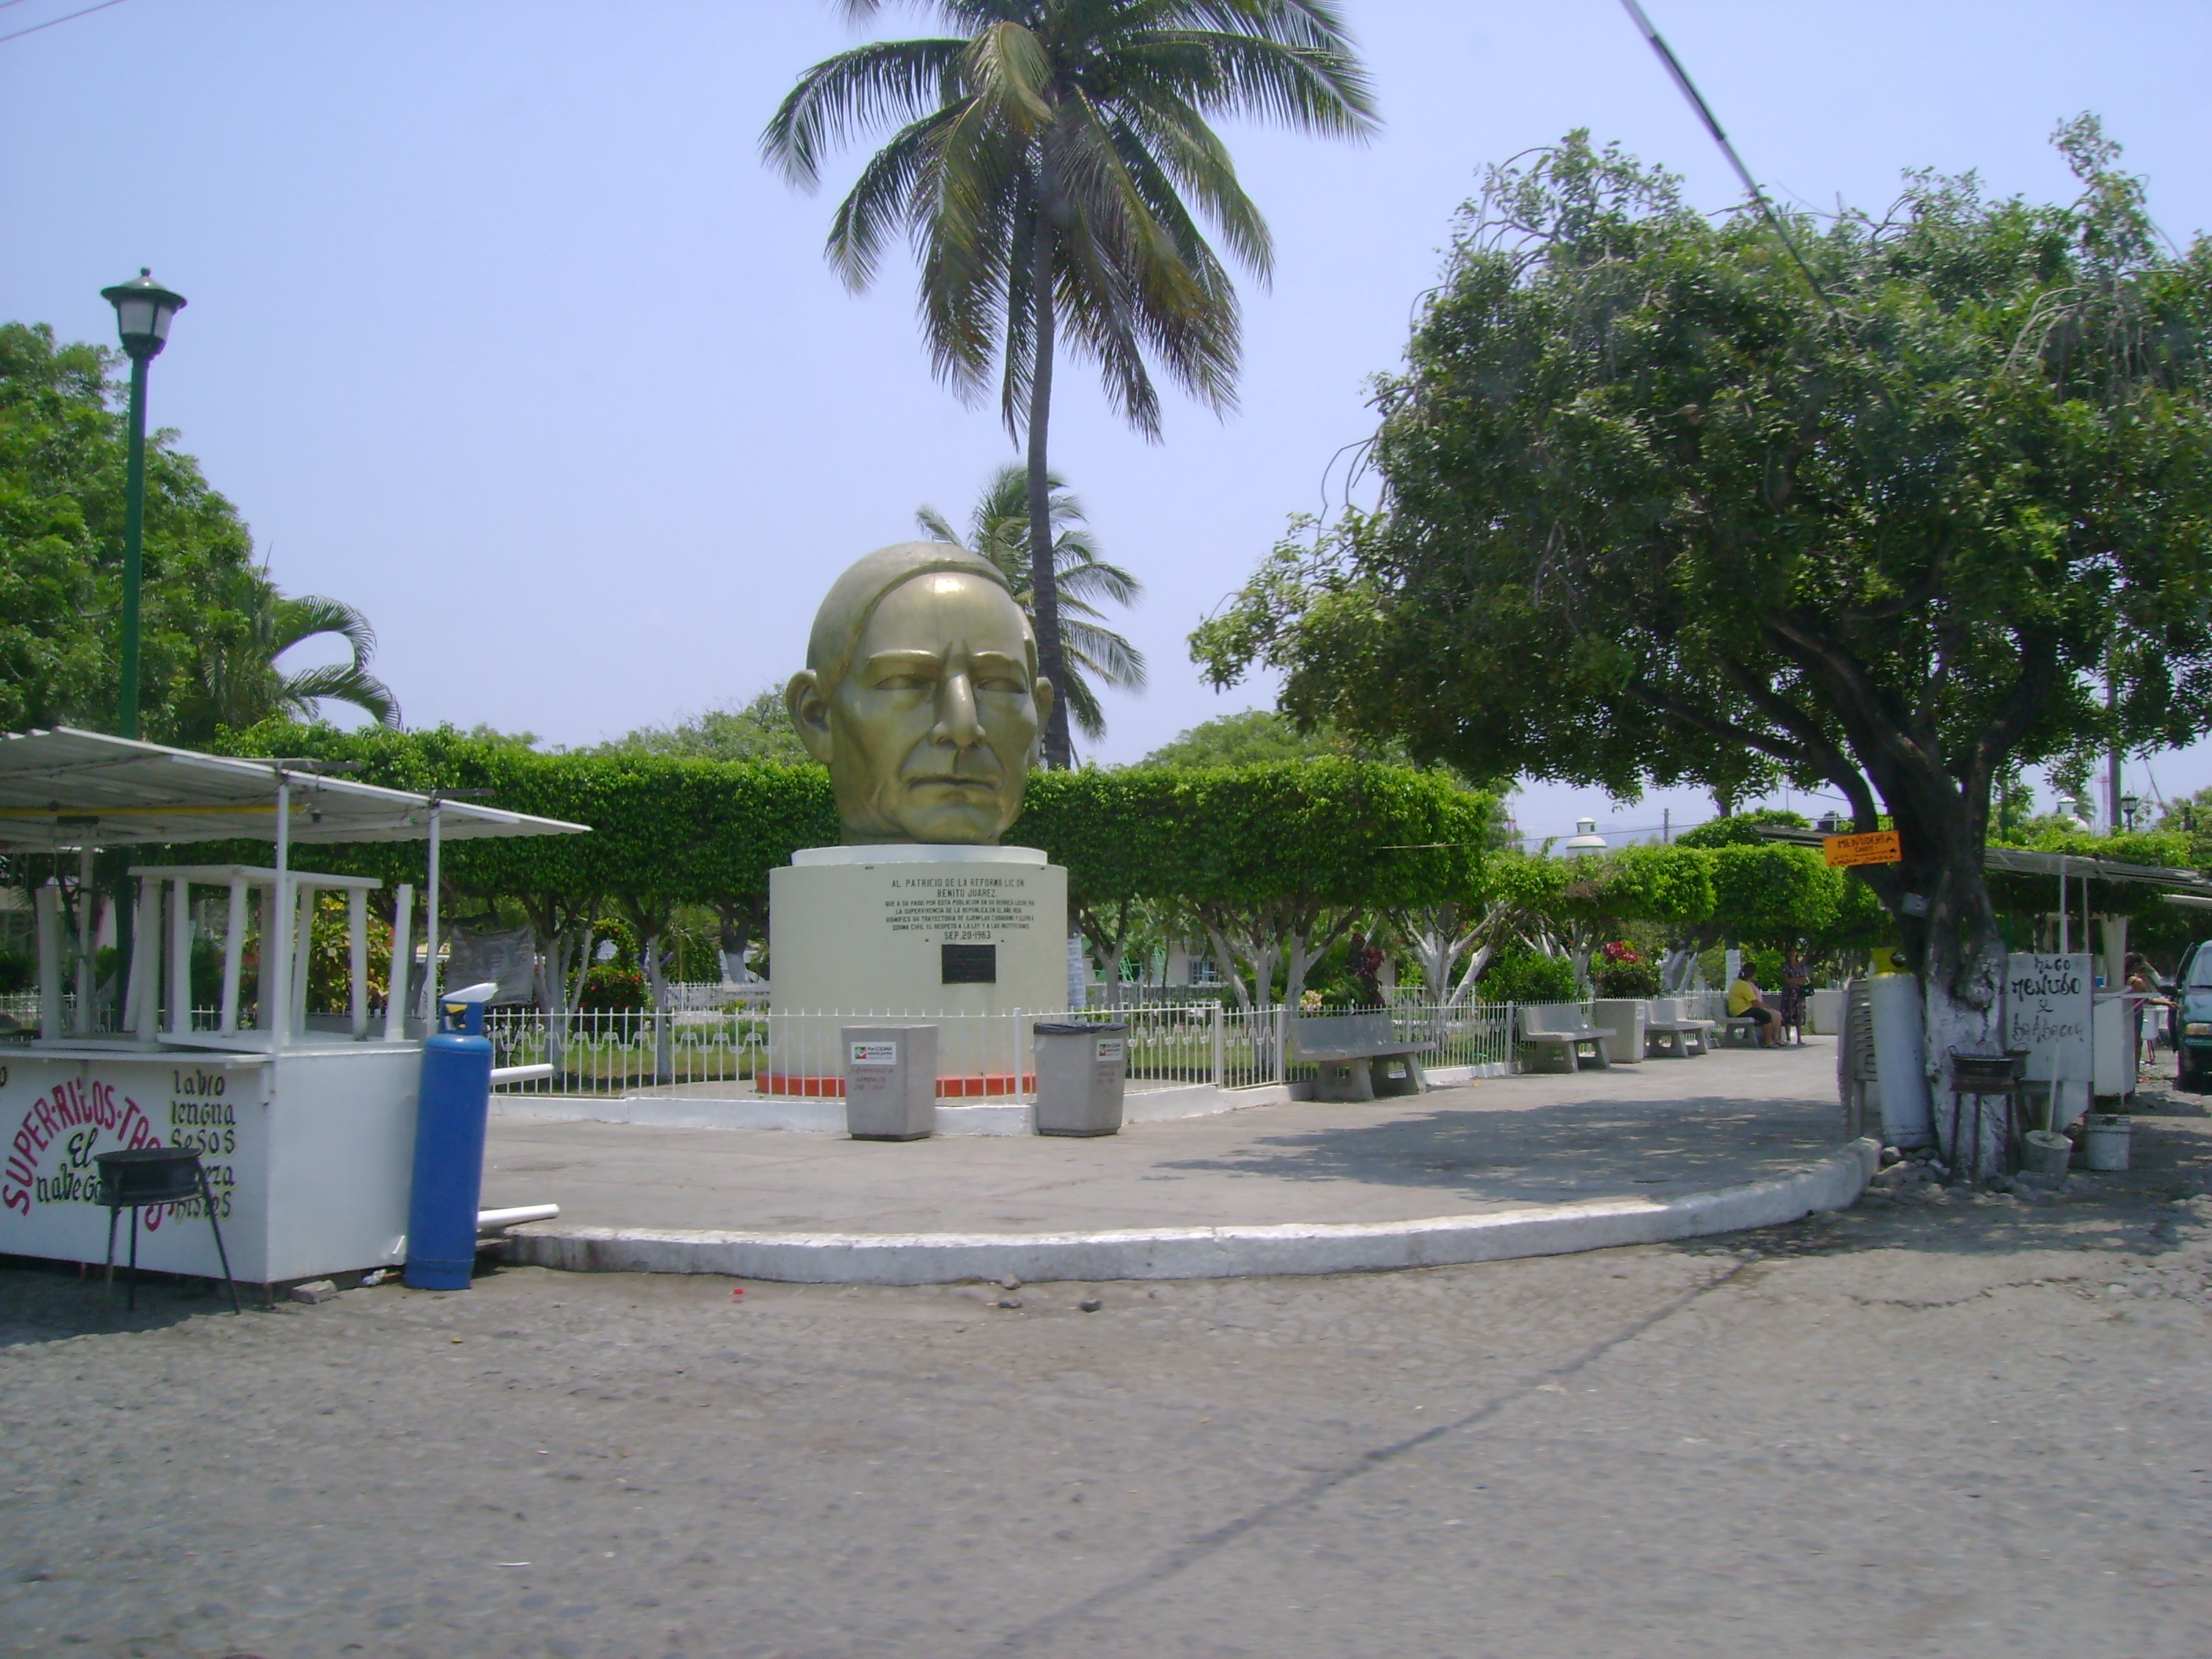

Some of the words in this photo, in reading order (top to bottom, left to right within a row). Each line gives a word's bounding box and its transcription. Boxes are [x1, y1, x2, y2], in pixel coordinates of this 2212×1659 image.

[892, 879, 902, 888] AL
[906, 878, 943, 888] PATRICIO
[945, 878, 954, 887] DE
[958, 878, 968, 887] LA
[970, 878, 1002, 887] REFORMA
[937, 888, 965, 898] BENITO
[68, 1127, 99, 1170] El
